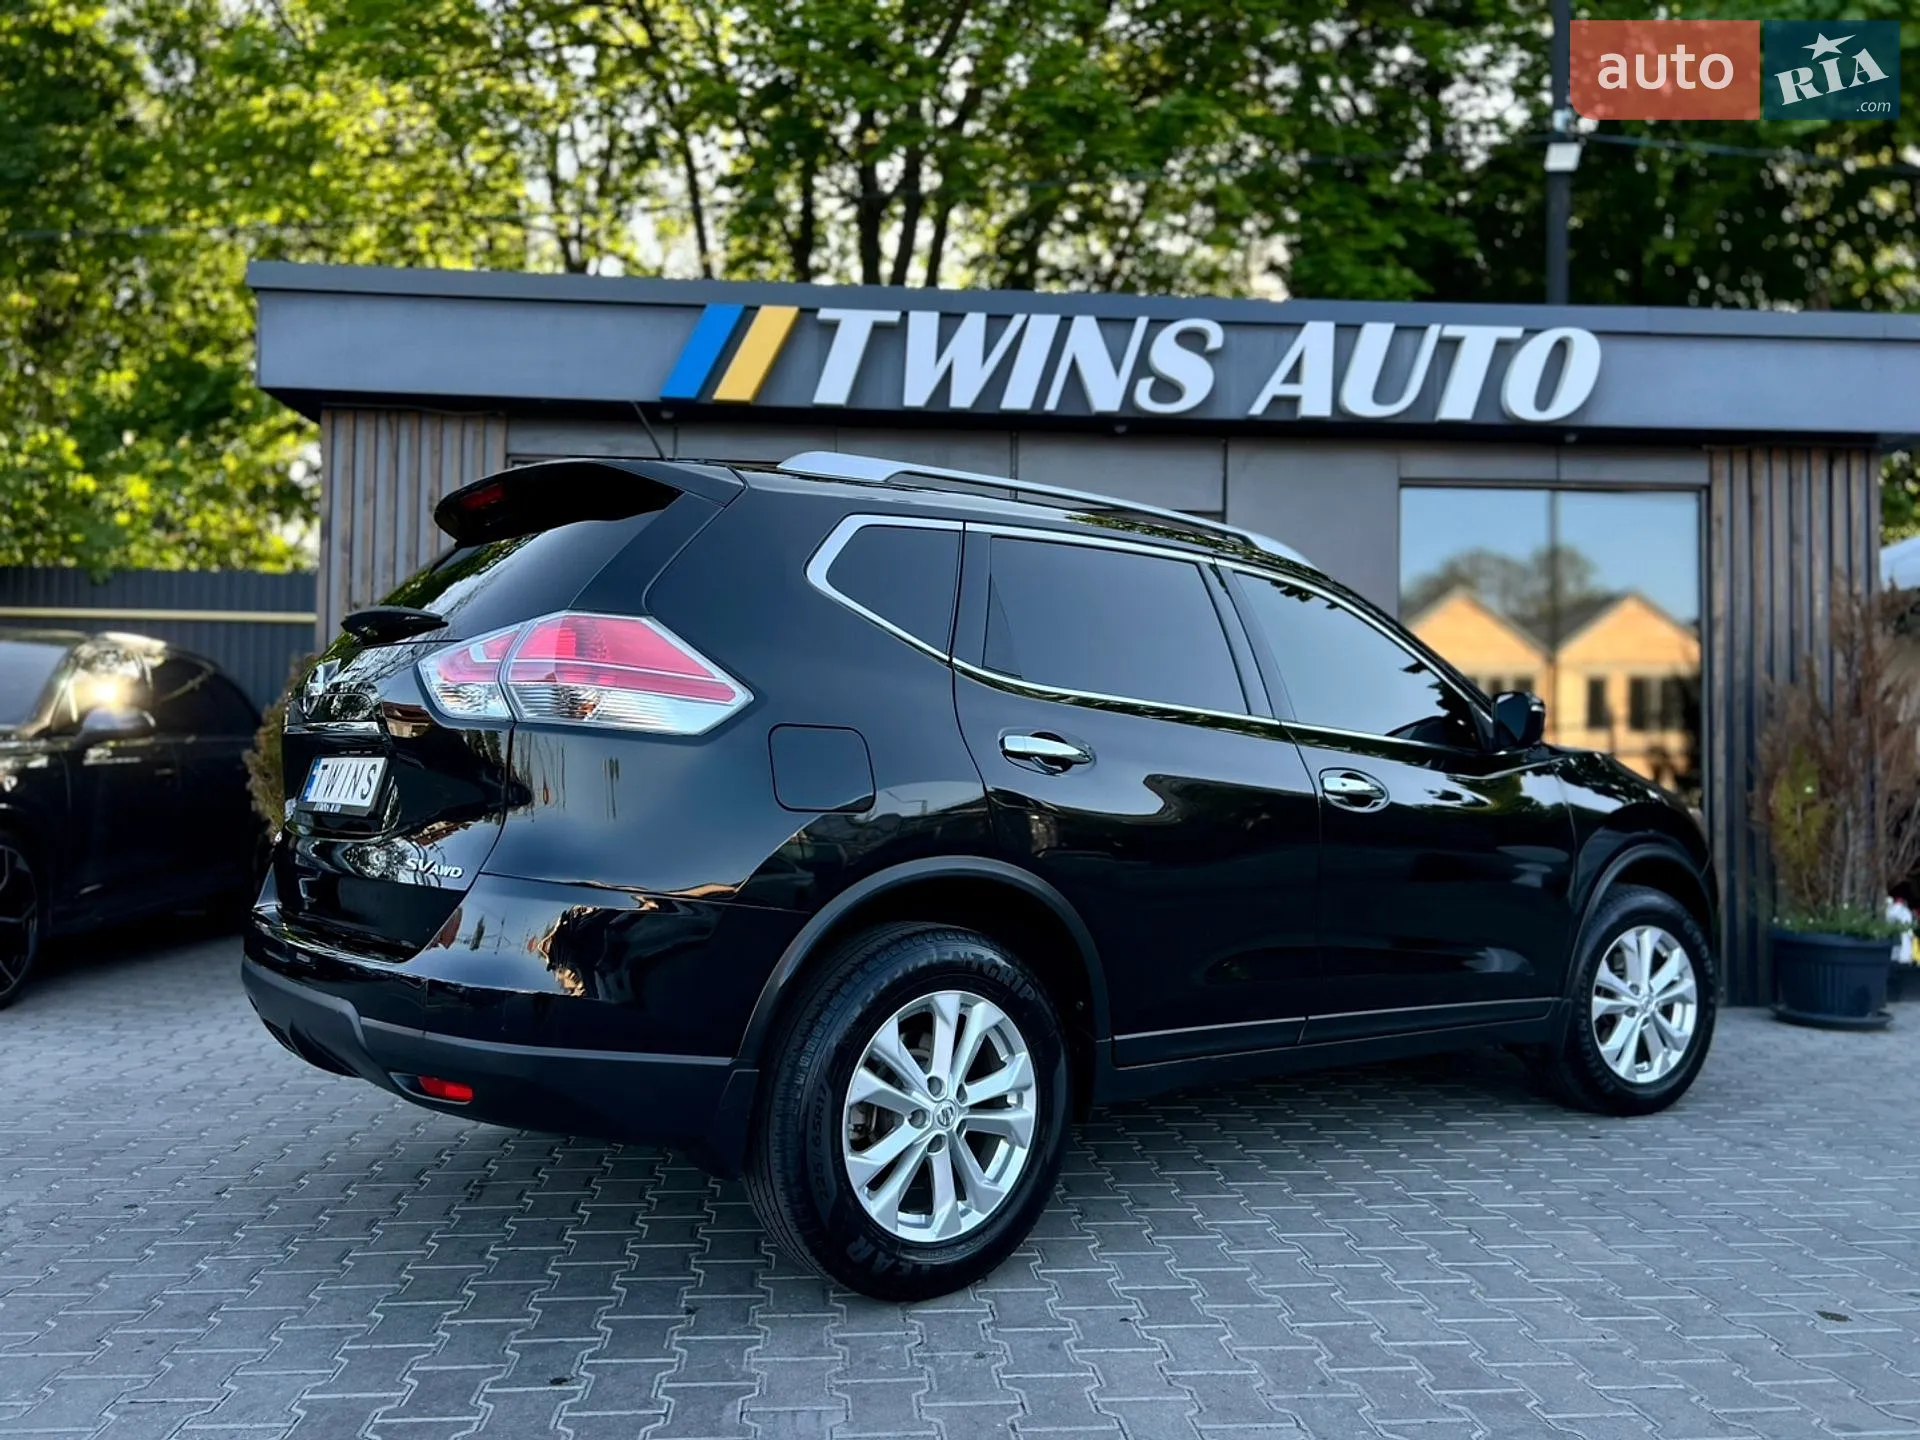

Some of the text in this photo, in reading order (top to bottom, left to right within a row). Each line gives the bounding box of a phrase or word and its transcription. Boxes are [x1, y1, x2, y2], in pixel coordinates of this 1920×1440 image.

[812, 307, 1603, 424] TWINS AUTO
[312, 763, 378, 800] TWINS
